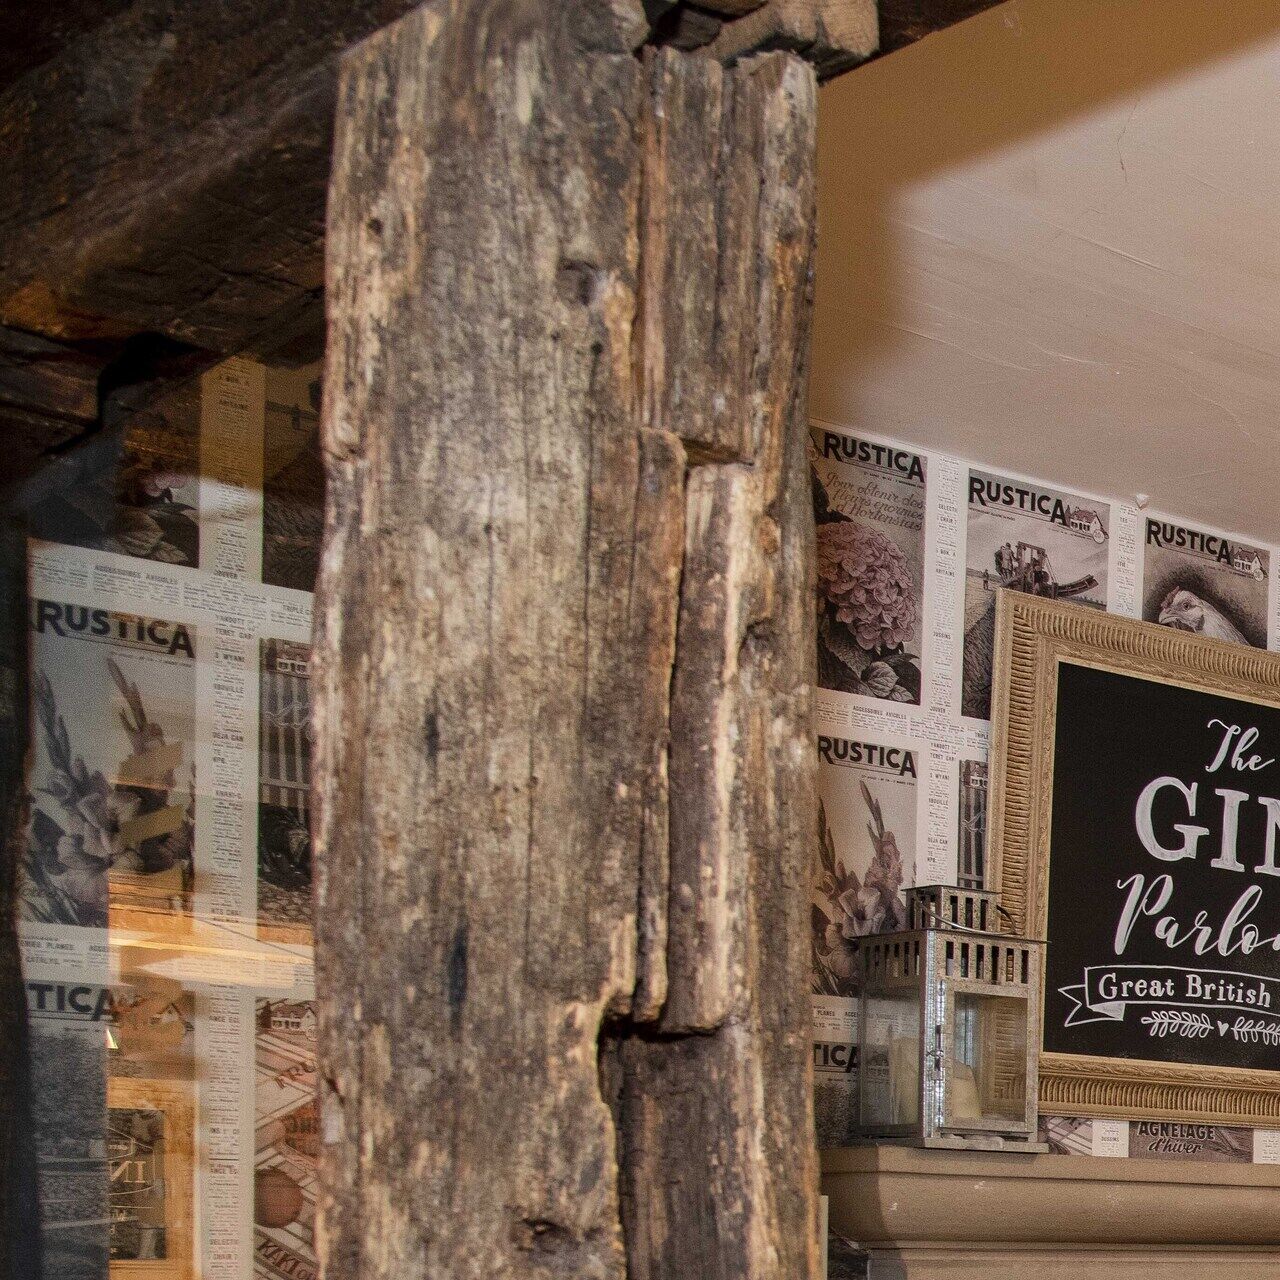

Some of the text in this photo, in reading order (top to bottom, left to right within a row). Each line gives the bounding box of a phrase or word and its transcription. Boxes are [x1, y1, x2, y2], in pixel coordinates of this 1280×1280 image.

[824, 432, 924, 483] RUSTICA
[969, 476, 1070, 527] RUSTICA
[1147, 520, 1234, 567] RUSTICA
[38, 600, 196, 658] RUSTICA
[818, 736, 916, 778] RUSTICA
[1205, 719, 1275, 772] The
[28, 982, 118, 1022] TICA
[1099, 972, 1174, 999] Great
[1185, 974, 1270, 1007] British
[1138, 1121, 1215, 1139] AGNELAGE
[1149, 1138, 1202, 1153] d'hiver
